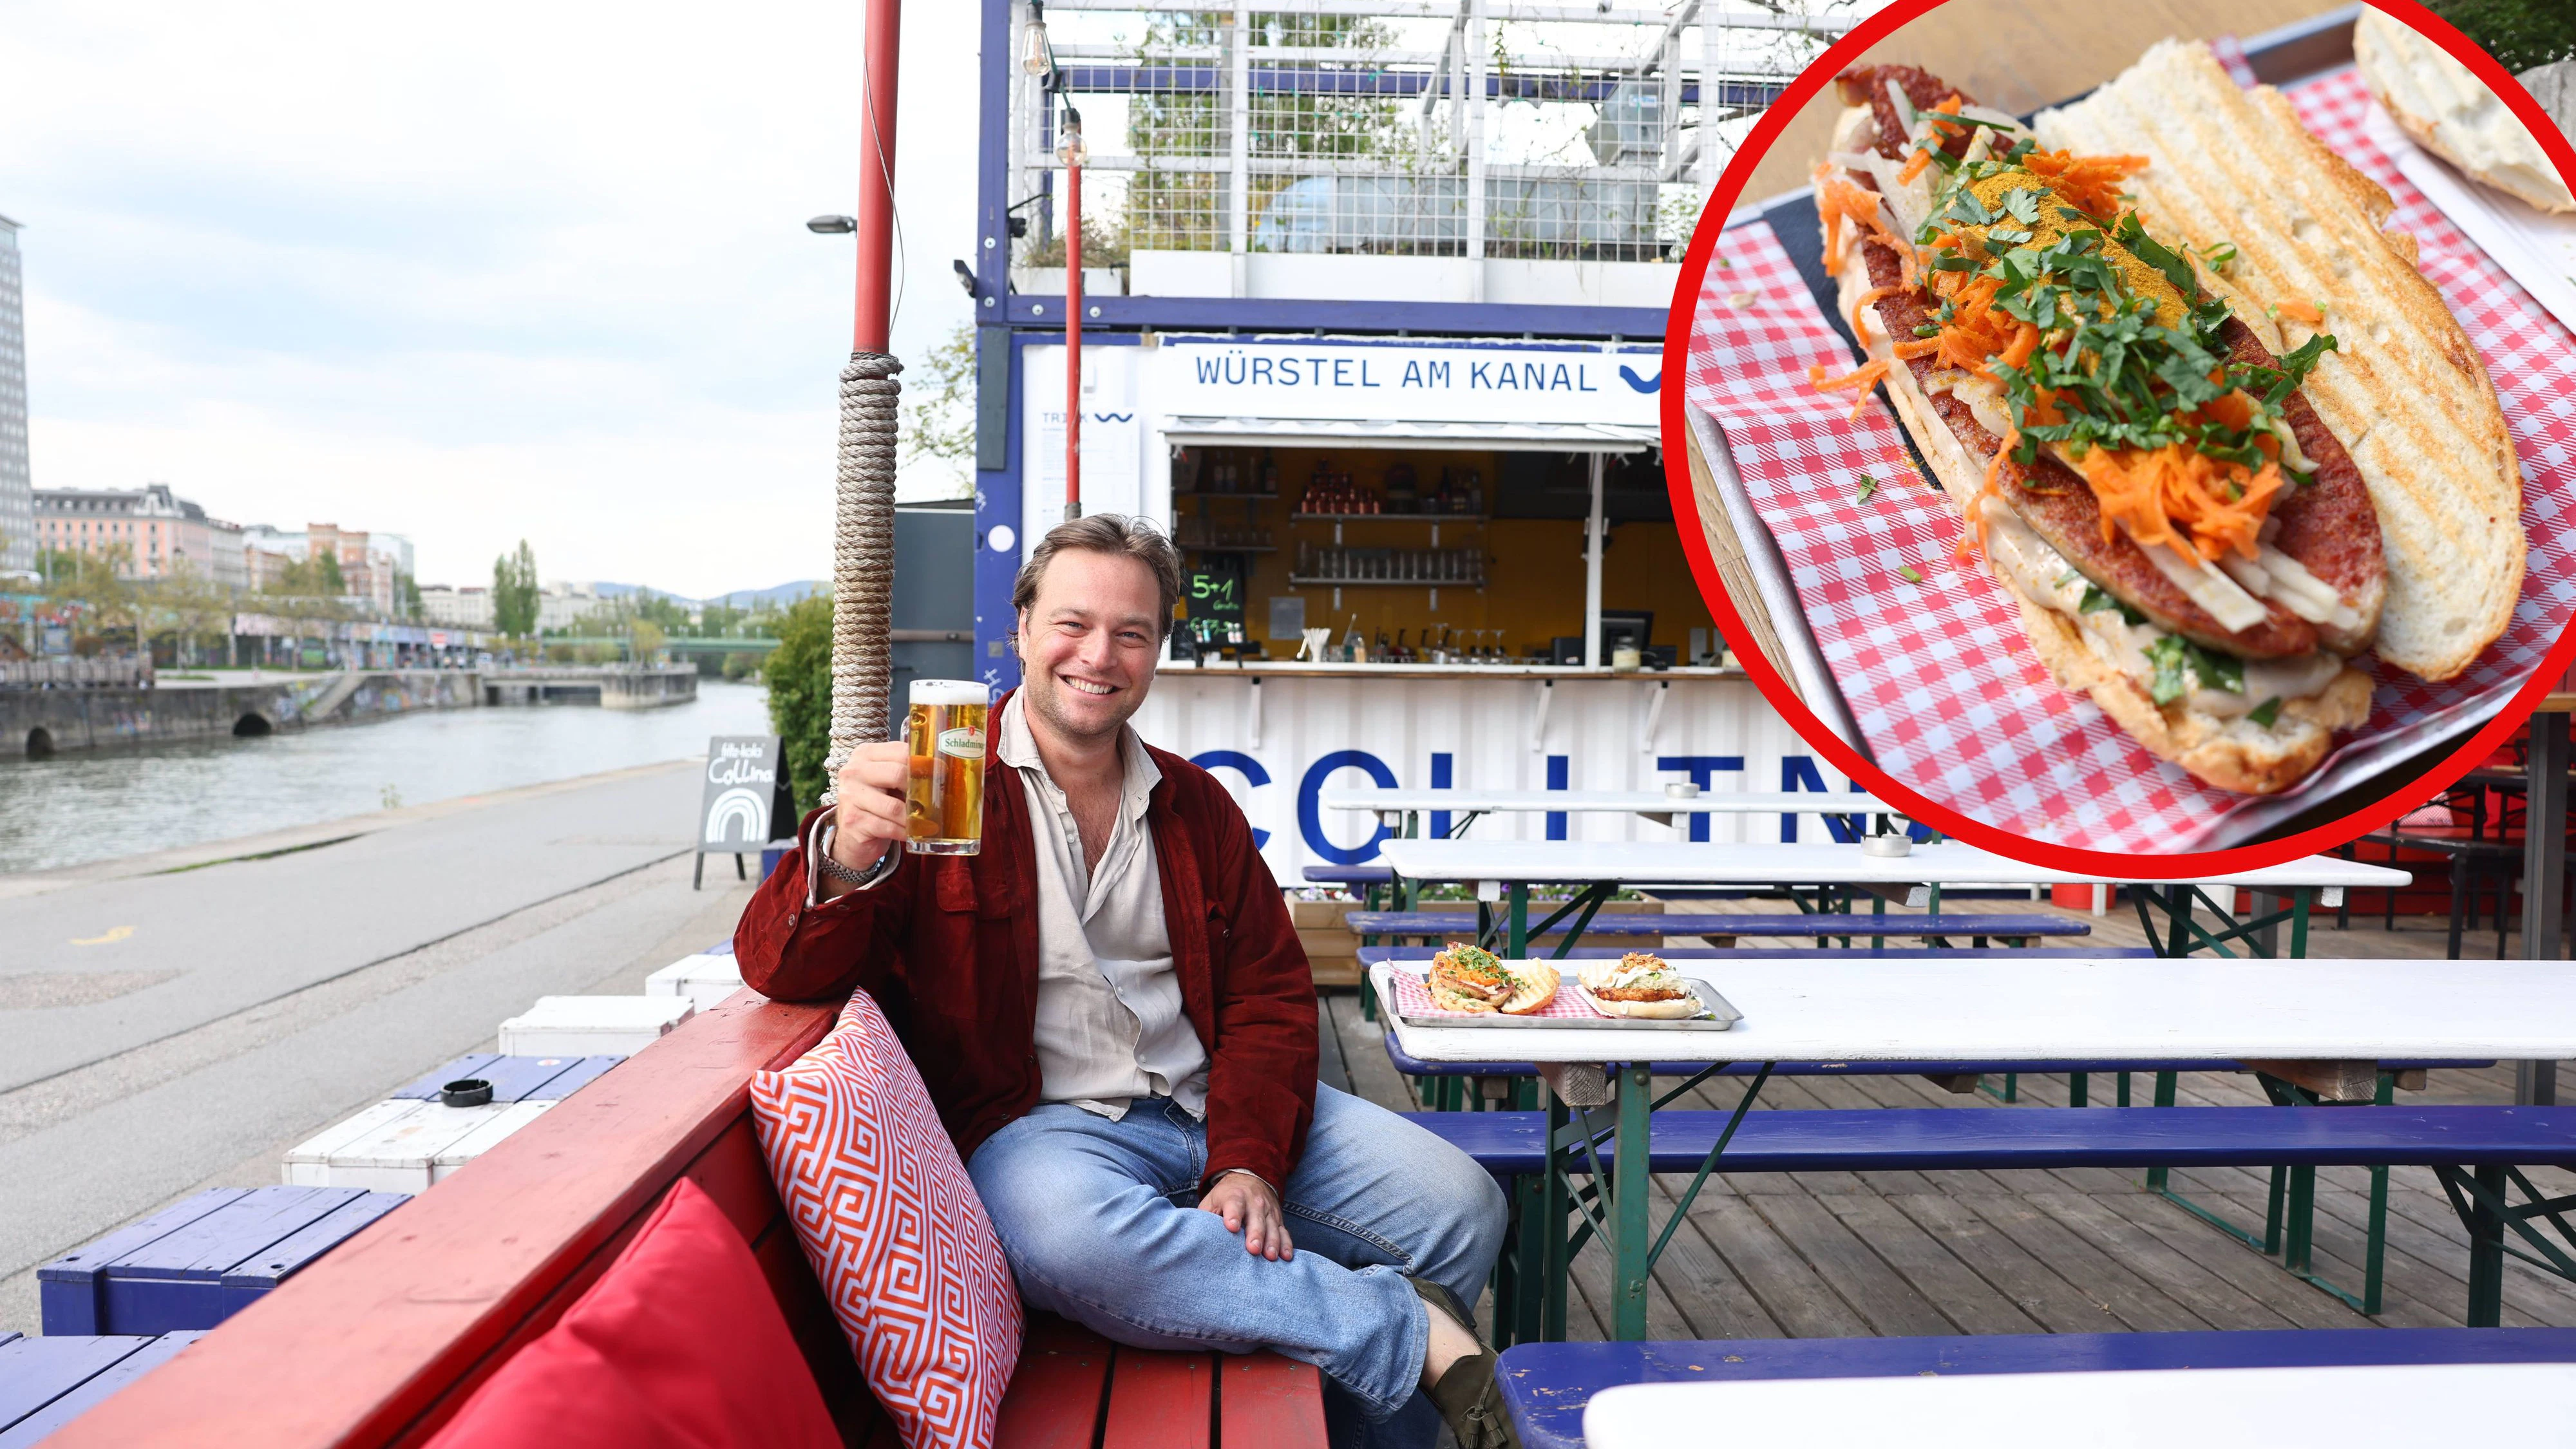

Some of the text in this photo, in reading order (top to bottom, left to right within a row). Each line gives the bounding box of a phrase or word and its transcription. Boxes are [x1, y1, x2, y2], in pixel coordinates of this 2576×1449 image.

[1196, 350, 1598, 392] WÜRSTEL AM KANAL
[1041, 412, 1088, 423] TRIK
[1191, 574, 1233, 601] 5+1
[708, 757, 774, 785] Collina
